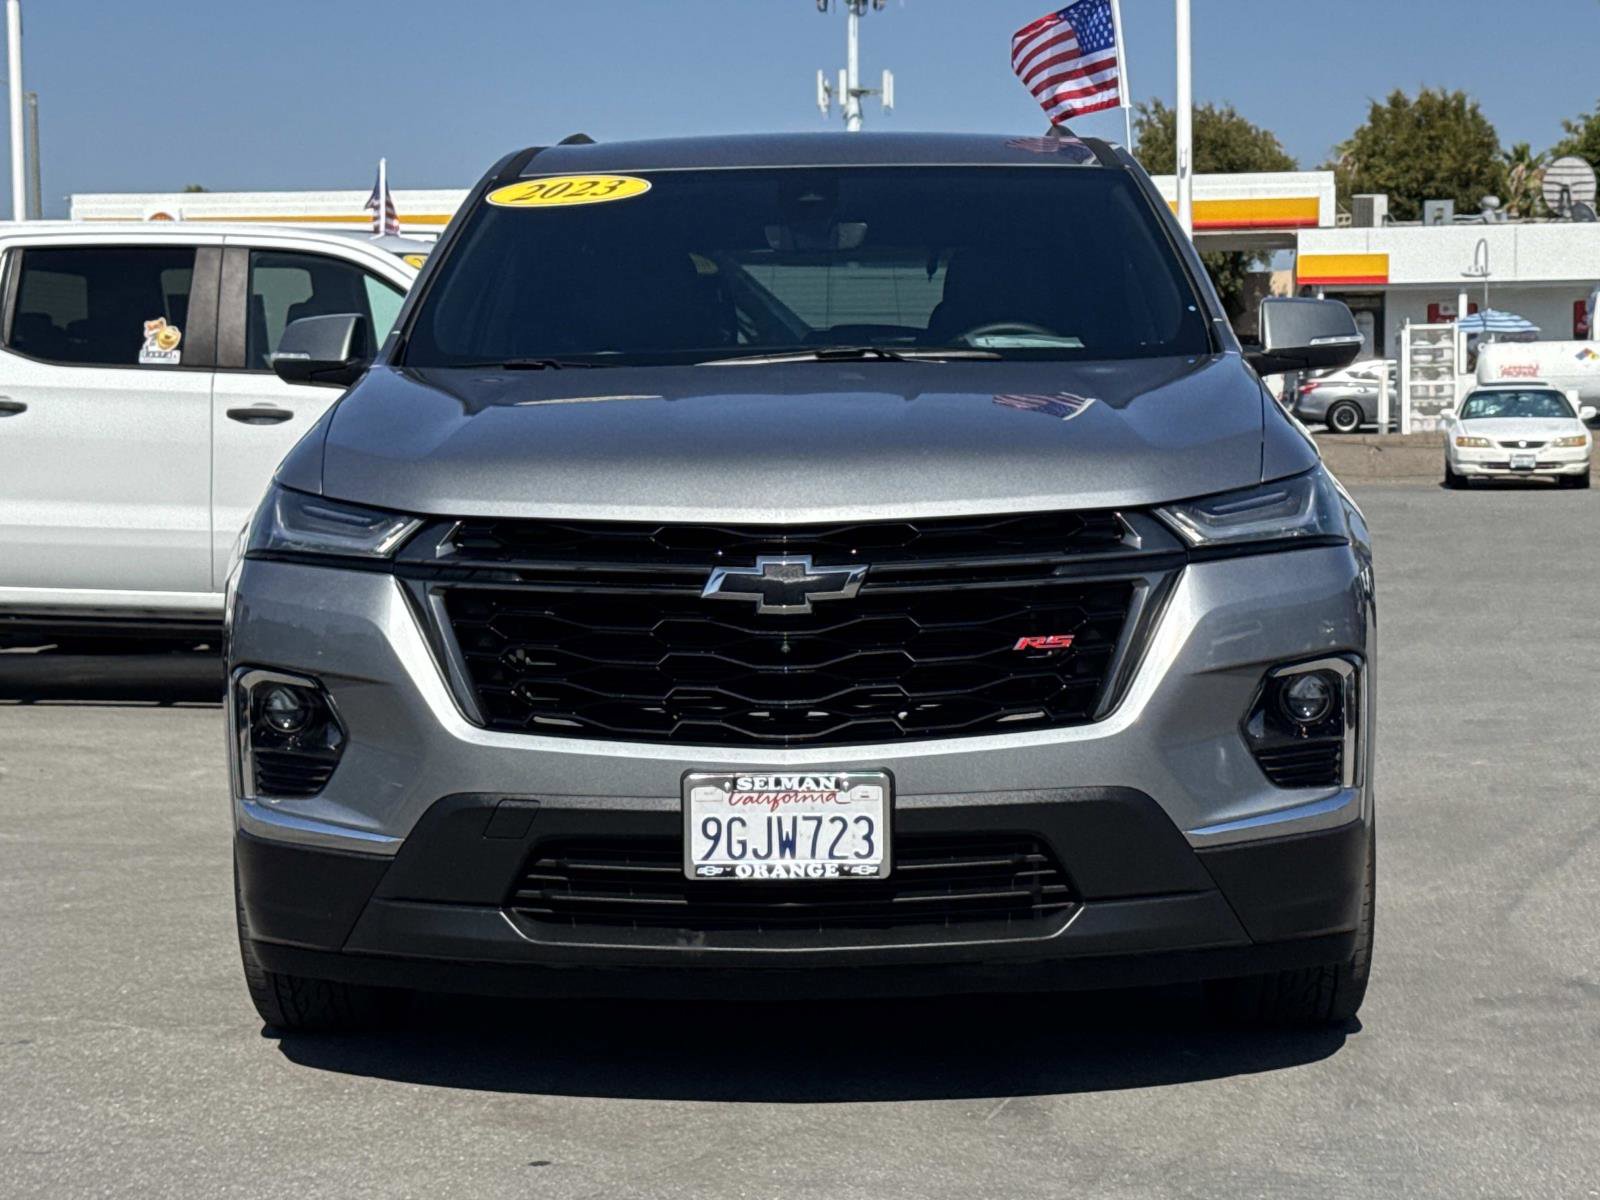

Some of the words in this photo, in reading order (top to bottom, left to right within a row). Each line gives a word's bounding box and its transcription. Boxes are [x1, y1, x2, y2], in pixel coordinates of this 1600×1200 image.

[510, 179, 627, 202] 2023
[1012, 634, 1075, 651] RS
[735, 777, 837, 791] SELMAN
[727, 790, 850, 812] California
[701, 815, 875, 861] 9GJW723
[735, 863, 840, 878] ORANGE
